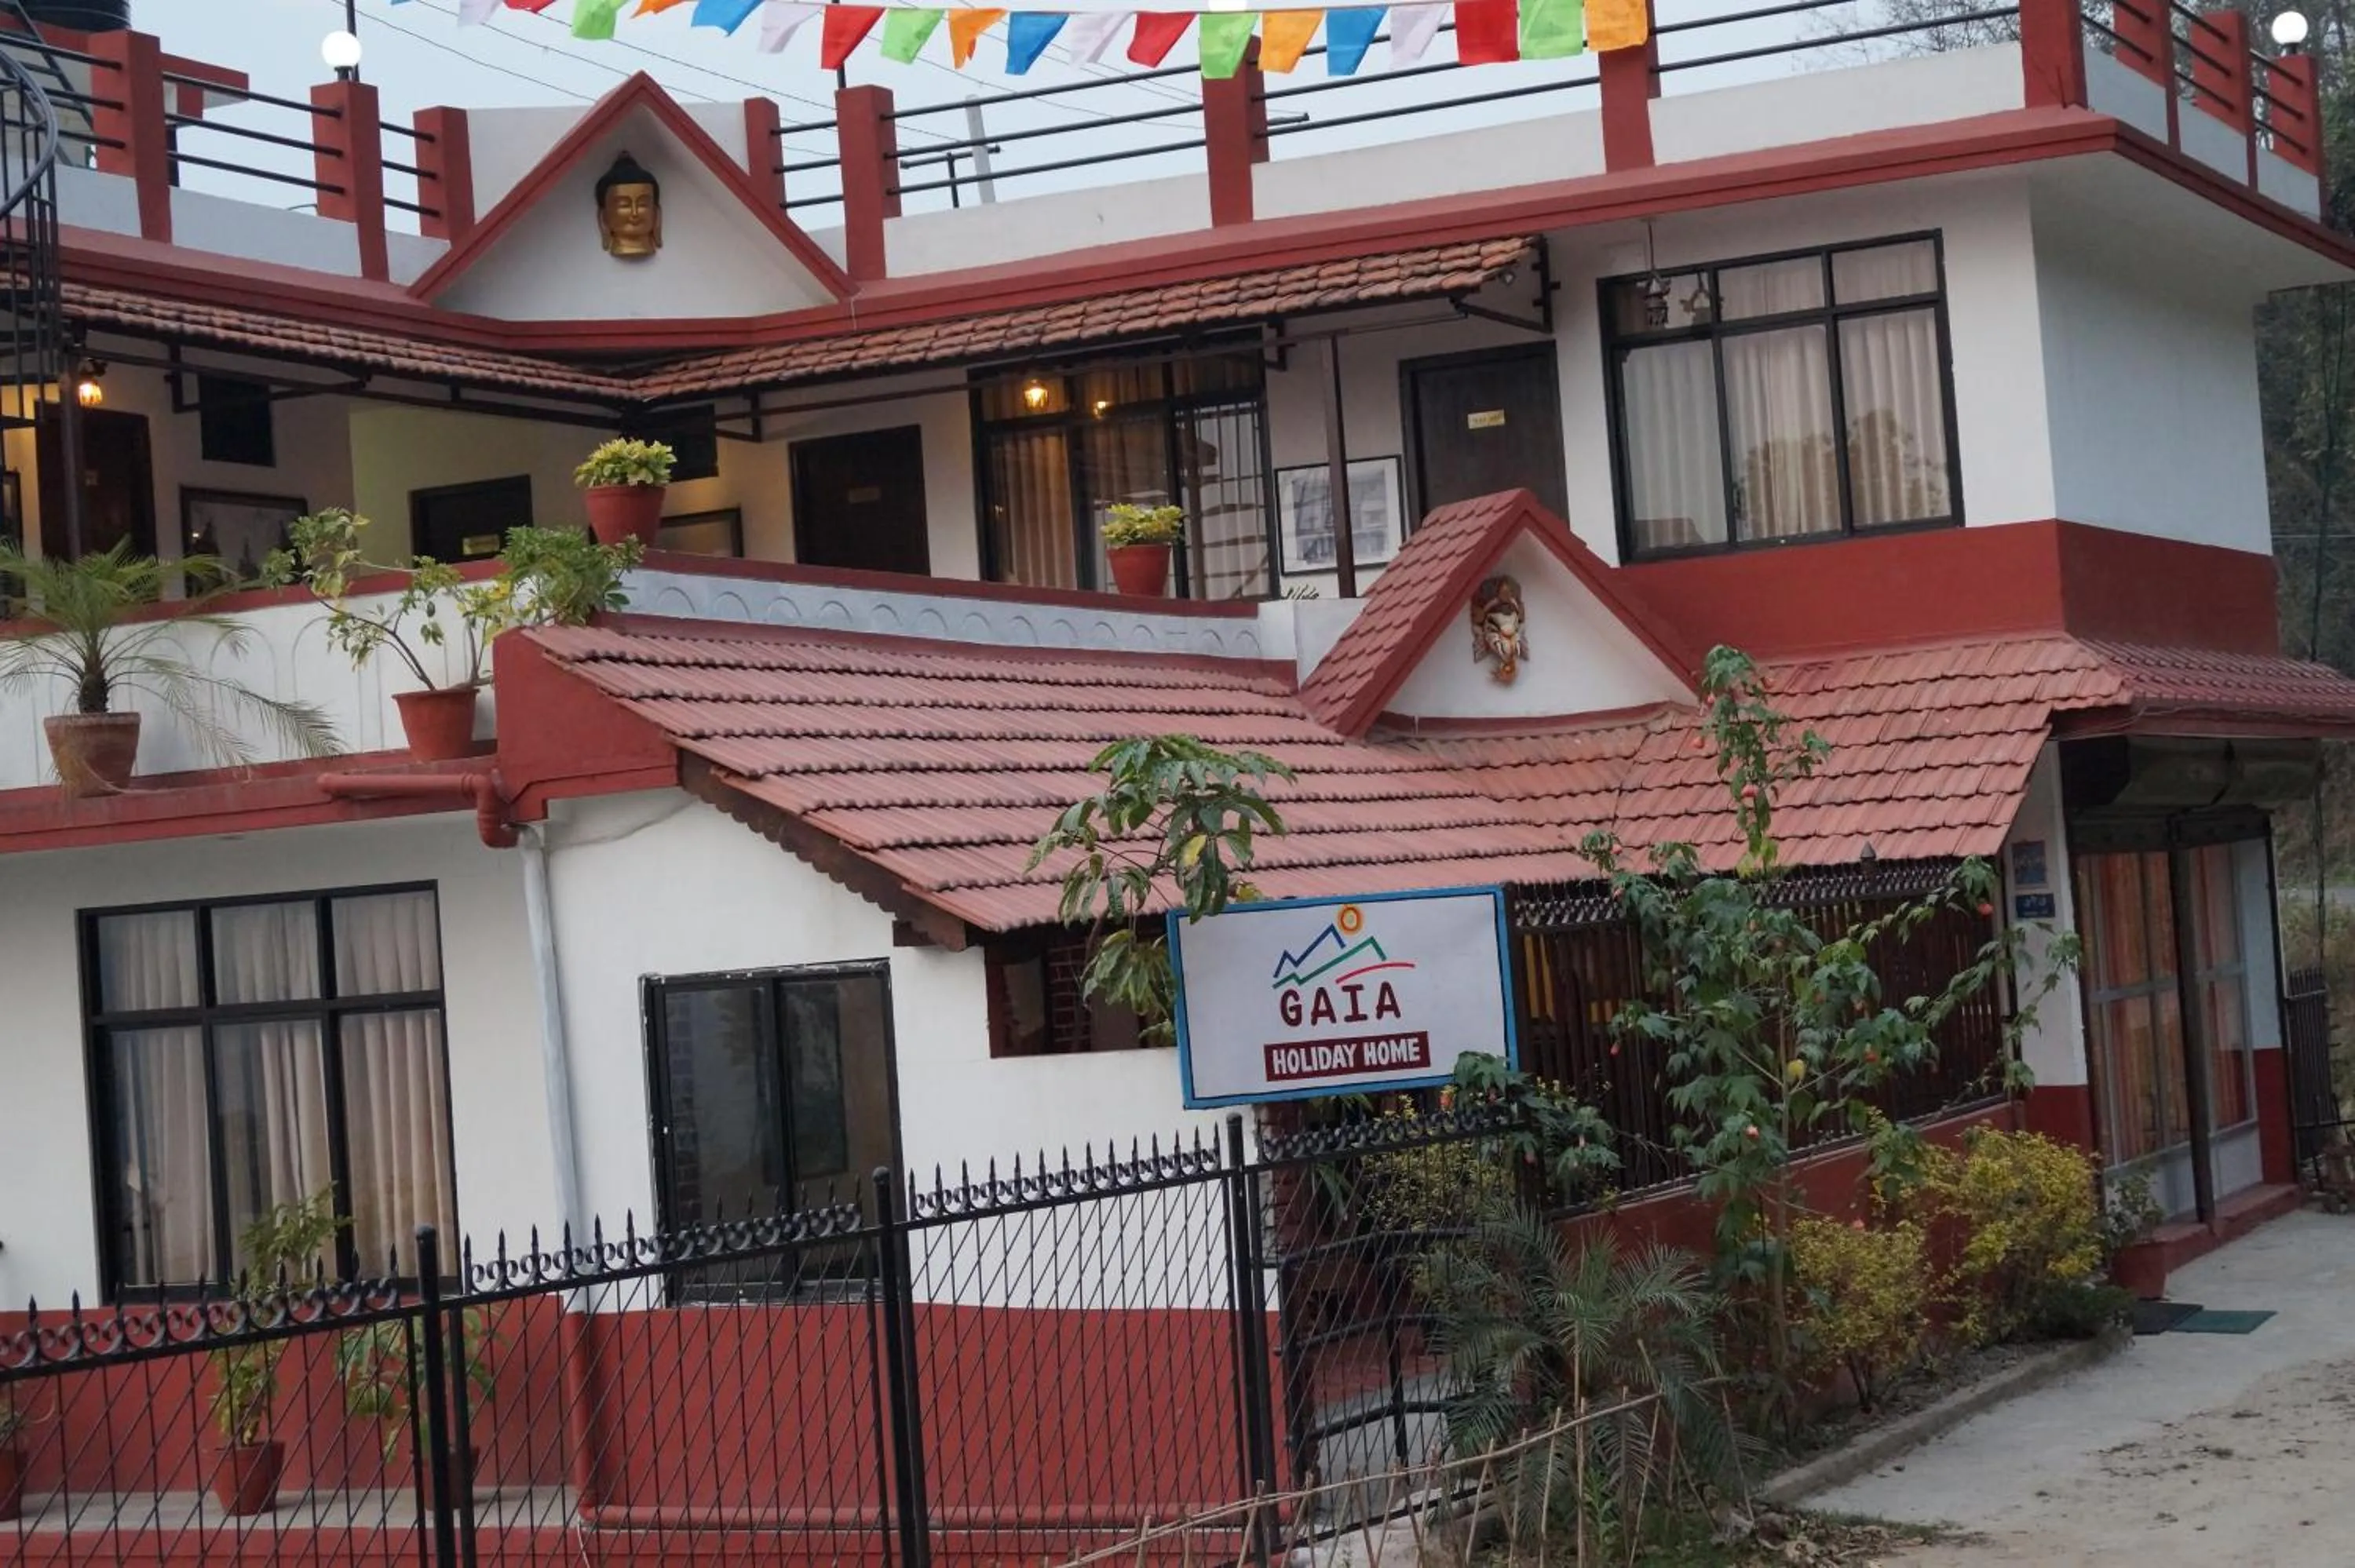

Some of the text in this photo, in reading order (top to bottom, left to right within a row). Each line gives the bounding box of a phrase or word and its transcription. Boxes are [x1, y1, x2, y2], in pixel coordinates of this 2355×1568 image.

[1280, 981, 1401, 1026] GAIA
[1272, 1038, 1420, 1074] HOLIDAY HOME
